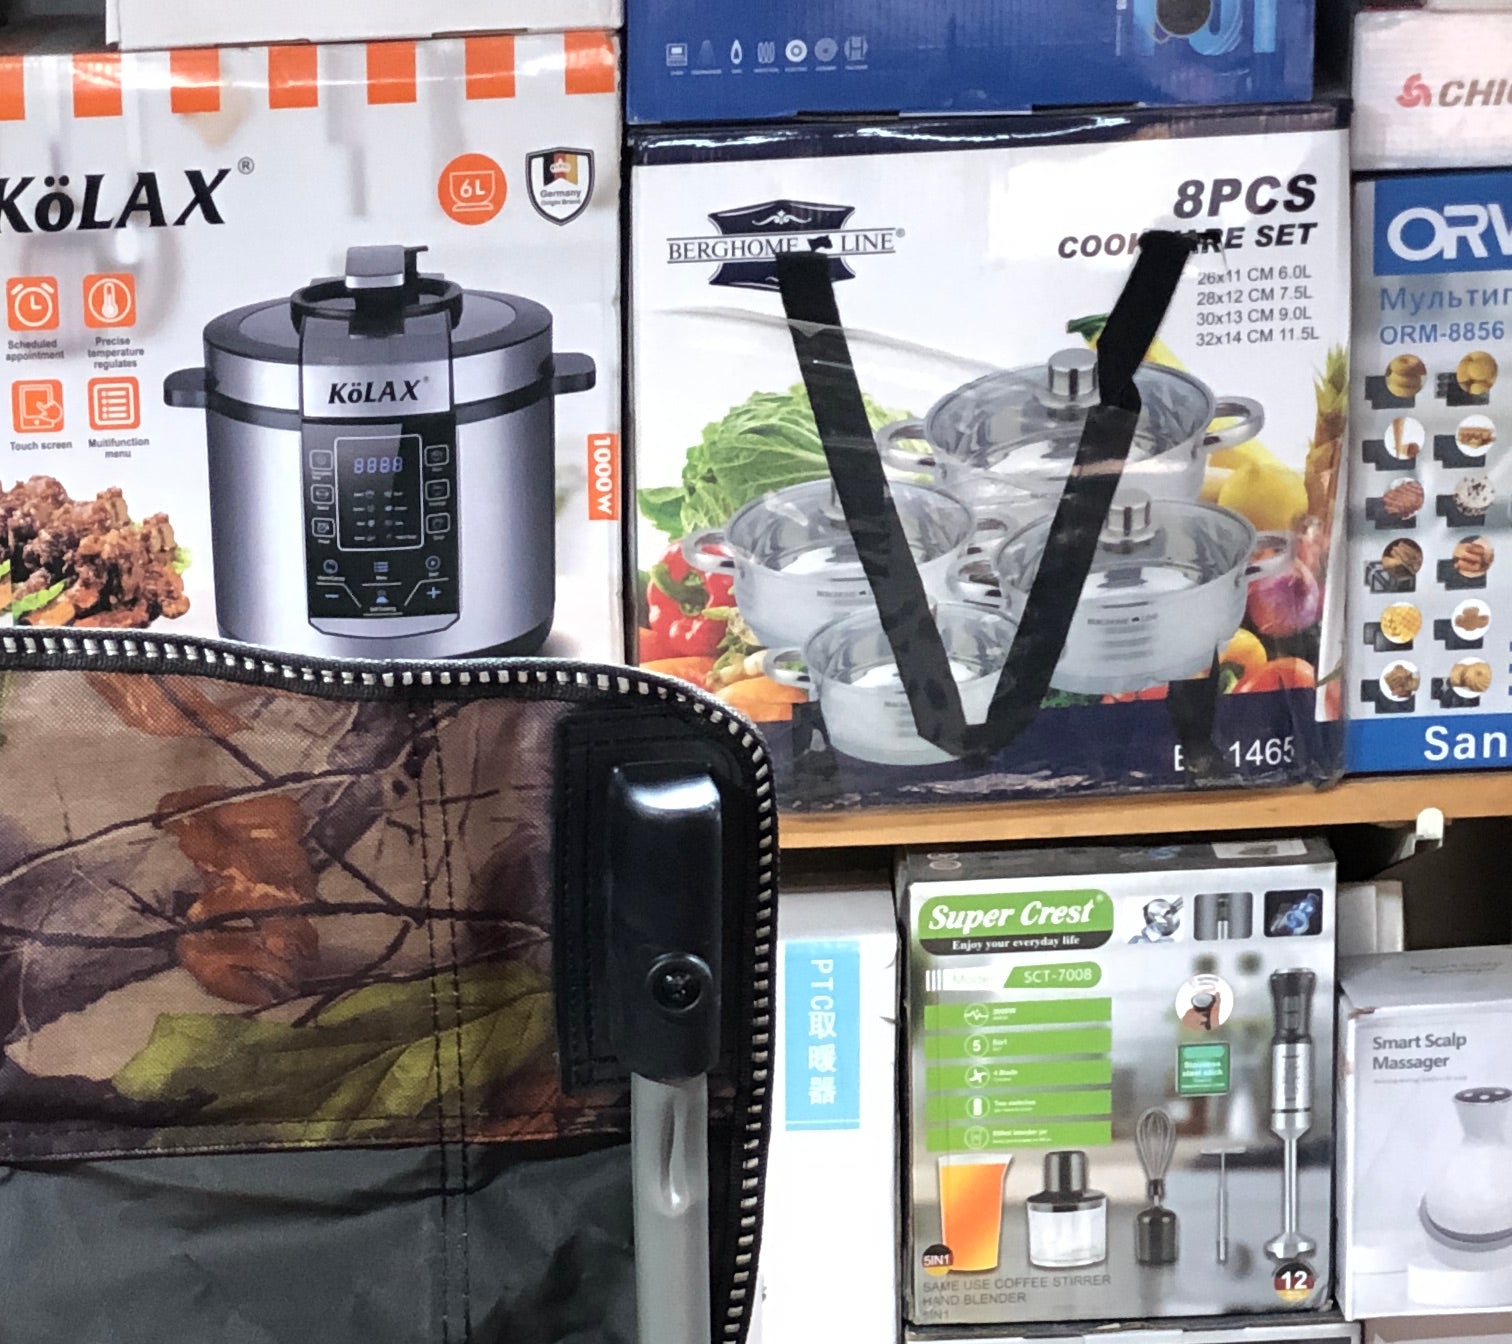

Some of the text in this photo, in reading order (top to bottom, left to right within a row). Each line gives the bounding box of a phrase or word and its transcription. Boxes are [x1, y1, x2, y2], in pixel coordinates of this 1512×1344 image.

[460, 179, 486, 198] 6L
[540, 189, 581, 199] Germany
[1173, 174, 1317, 219] 8PCS
[841, 232, 894, 252] LINE
[1255, 222, 1318, 247] SET
[1197, 265, 1311, 286] 26x11 CM 6.0L
[1197, 285, 1312, 306] 28x12 CM 7.5L
[1196, 306, 1312, 326] 30x13 CM 9.0L
[95, 337, 130, 346] Precise
[1196, 326, 1319, 347] 32x14 CM 11.5L
[1379, 321, 1505, 345] ORM-8856
[8, 339, 57, 350] Scheduled
[88, 348, 144, 358] temperature
[6, 351, 65, 362] appointment
[94, 359, 137, 370] regulates
[328, 380, 420, 405] KöLAX
[10, 441, 72, 450] Touch screen
[88, 437, 149, 448] Multifunction
[105, 450, 131, 458] menu
[593, 435, 613, 515] 1000W
[928, 899, 1095, 934] Super Crest
[952, 935, 1081, 951] Enjoy your everyday life
[1024, 967, 1093, 983] SCT-7008
[972, 1040, 981, 1052] 5
[1372, 1032, 1467, 1050] Smart Scalp
[1372, 1056, 1450, 1072] Massager
[923, 1255, 950, 1266] 5IN1
[923, 1274, 1111, 1293] SAME USE COFFEE STIRRER
[1281, 1270, 1307, 1290] 12
[923, 1292, 1026, 1306] HAND BLENDER
